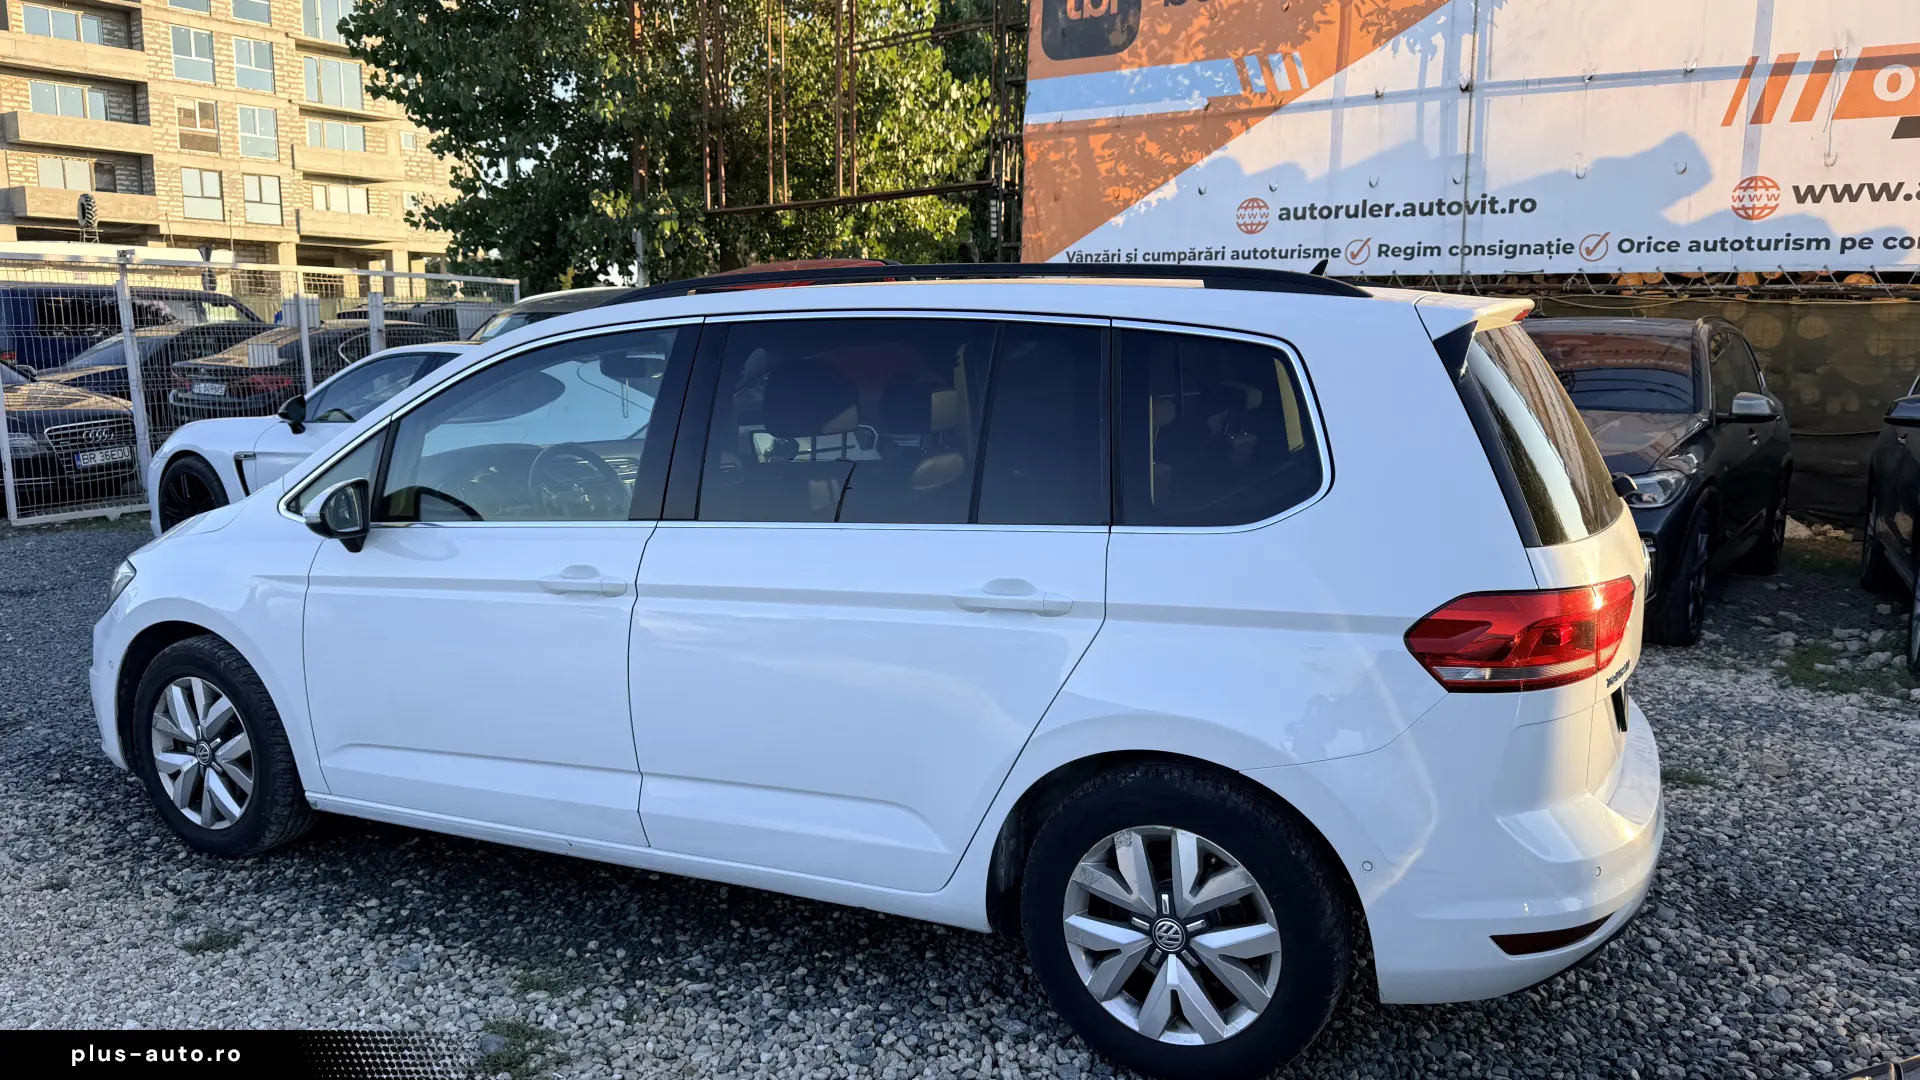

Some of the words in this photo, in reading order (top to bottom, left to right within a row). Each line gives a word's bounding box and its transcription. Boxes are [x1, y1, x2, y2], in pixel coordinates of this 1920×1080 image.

[1792, 181, 1920, 204] www.
[1278, 193, 1537, 221] autoruler.autovit.ro
[1066, 249, 1121, 263] Vânzări
[1142, 246, 1225, 264] cumpărări
[1230, 244, 1342, 261] autoturisme
[1377, 241, 1442, 261] Regim
[1448, 238, 1575, 260] consignație
[1617, 235, 1681, 253] Orice
[1688, 233, 1831, 253] autoturism
[1840, 237, 1874, 254] pe
[1882, 236, 1920, 250] co
[81, 453, 96, 465] BR
